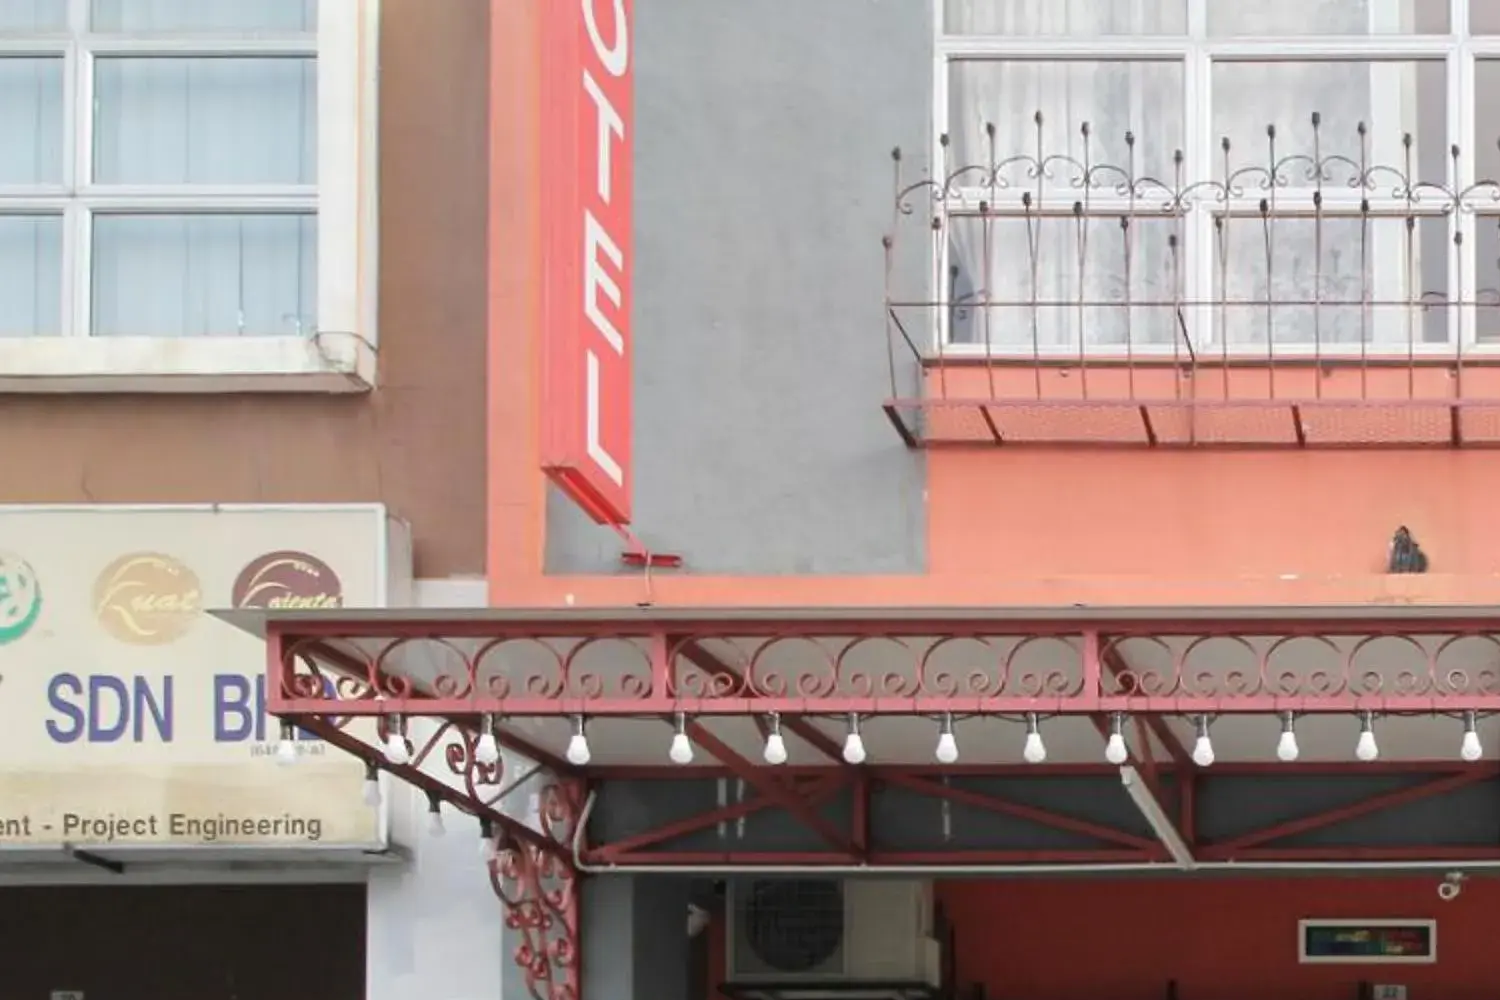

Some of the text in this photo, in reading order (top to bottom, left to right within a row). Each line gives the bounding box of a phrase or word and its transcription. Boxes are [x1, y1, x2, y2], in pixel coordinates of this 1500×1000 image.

[45, 673, 174, 744] SDN
[63, 813, 158, 842] Project
[168, 813, 323, 842] Engineering
